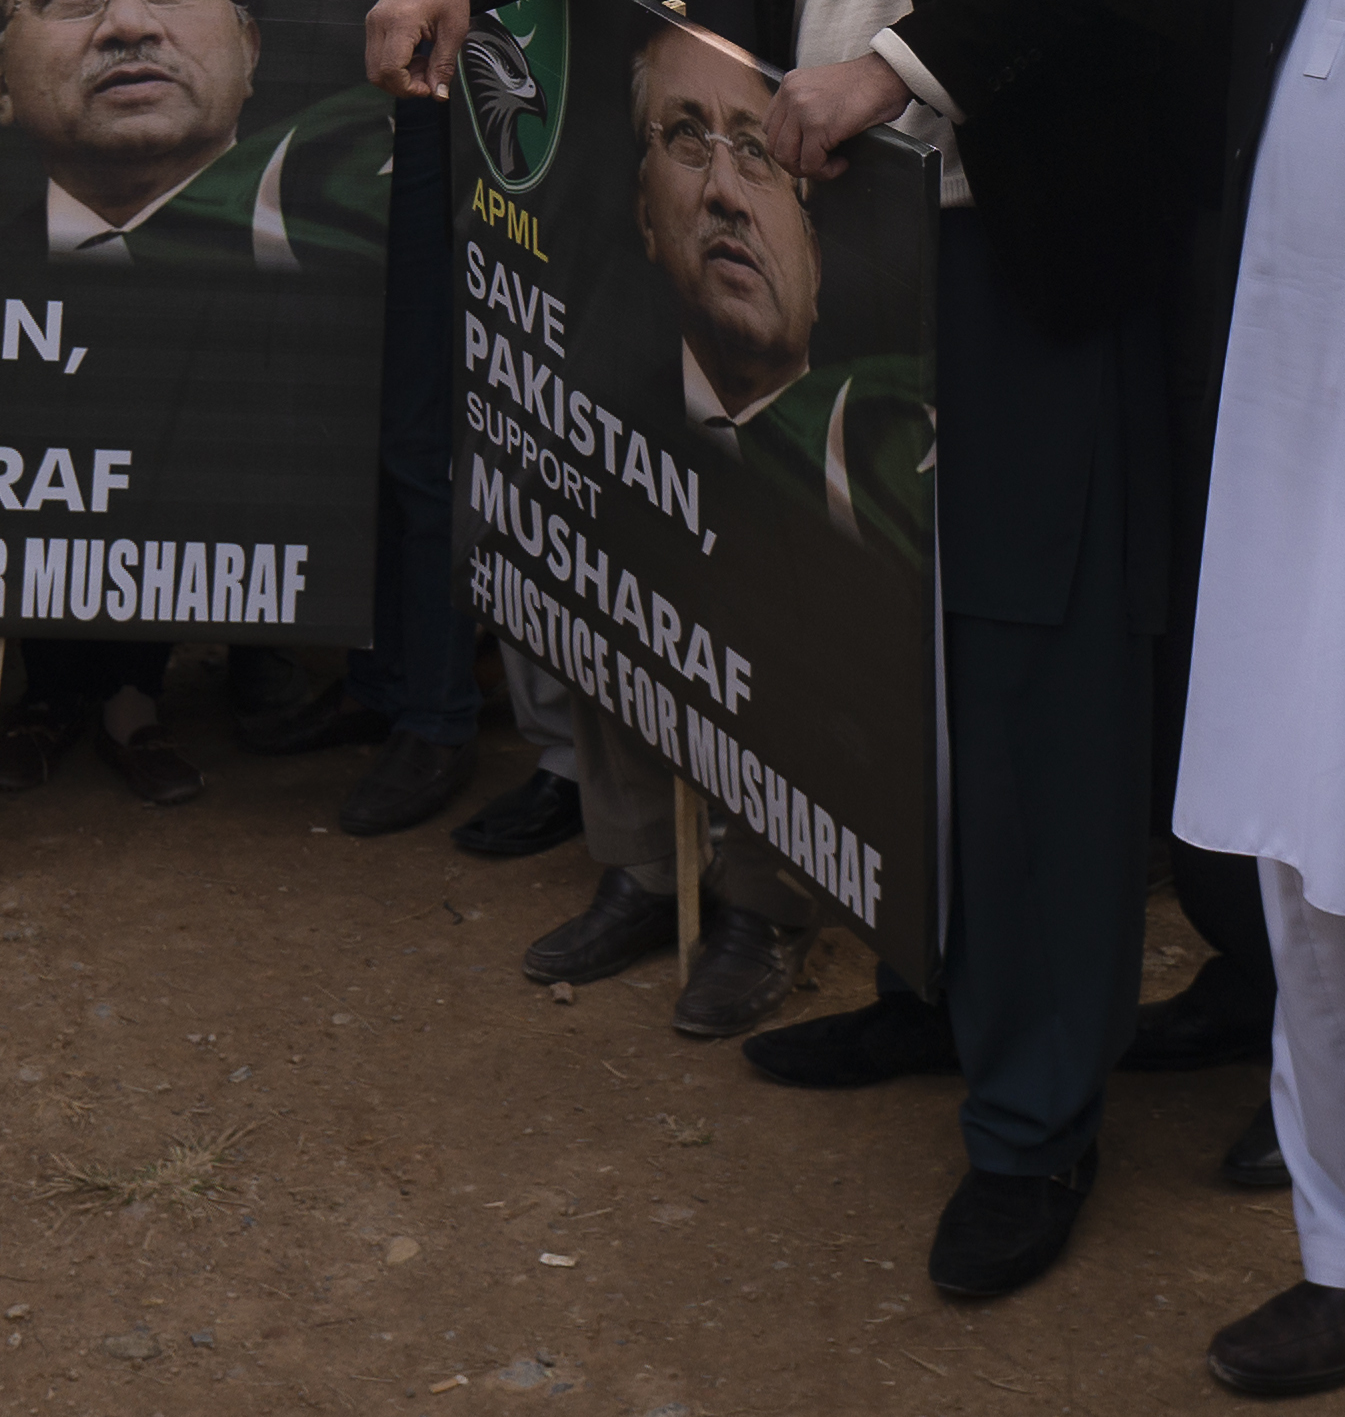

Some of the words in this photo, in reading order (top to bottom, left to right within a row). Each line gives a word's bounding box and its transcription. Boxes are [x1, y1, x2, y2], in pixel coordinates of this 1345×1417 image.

[470, 177, 549, 264] APML
[465, 240, 567, 359] SAVE
[464, 310, 720, 557] PAKISTAN,
[465, 391, 603, 520] SUPPORT
[21, 538, 309, 625] MUSHARAF
[470, 454, 753, 716] MUSHARAF
[469, 545, 612, 715] #JUSTICE
[616, 656, 681, 780] FOR
[686, 703, 883, 930] MUSHARAF
